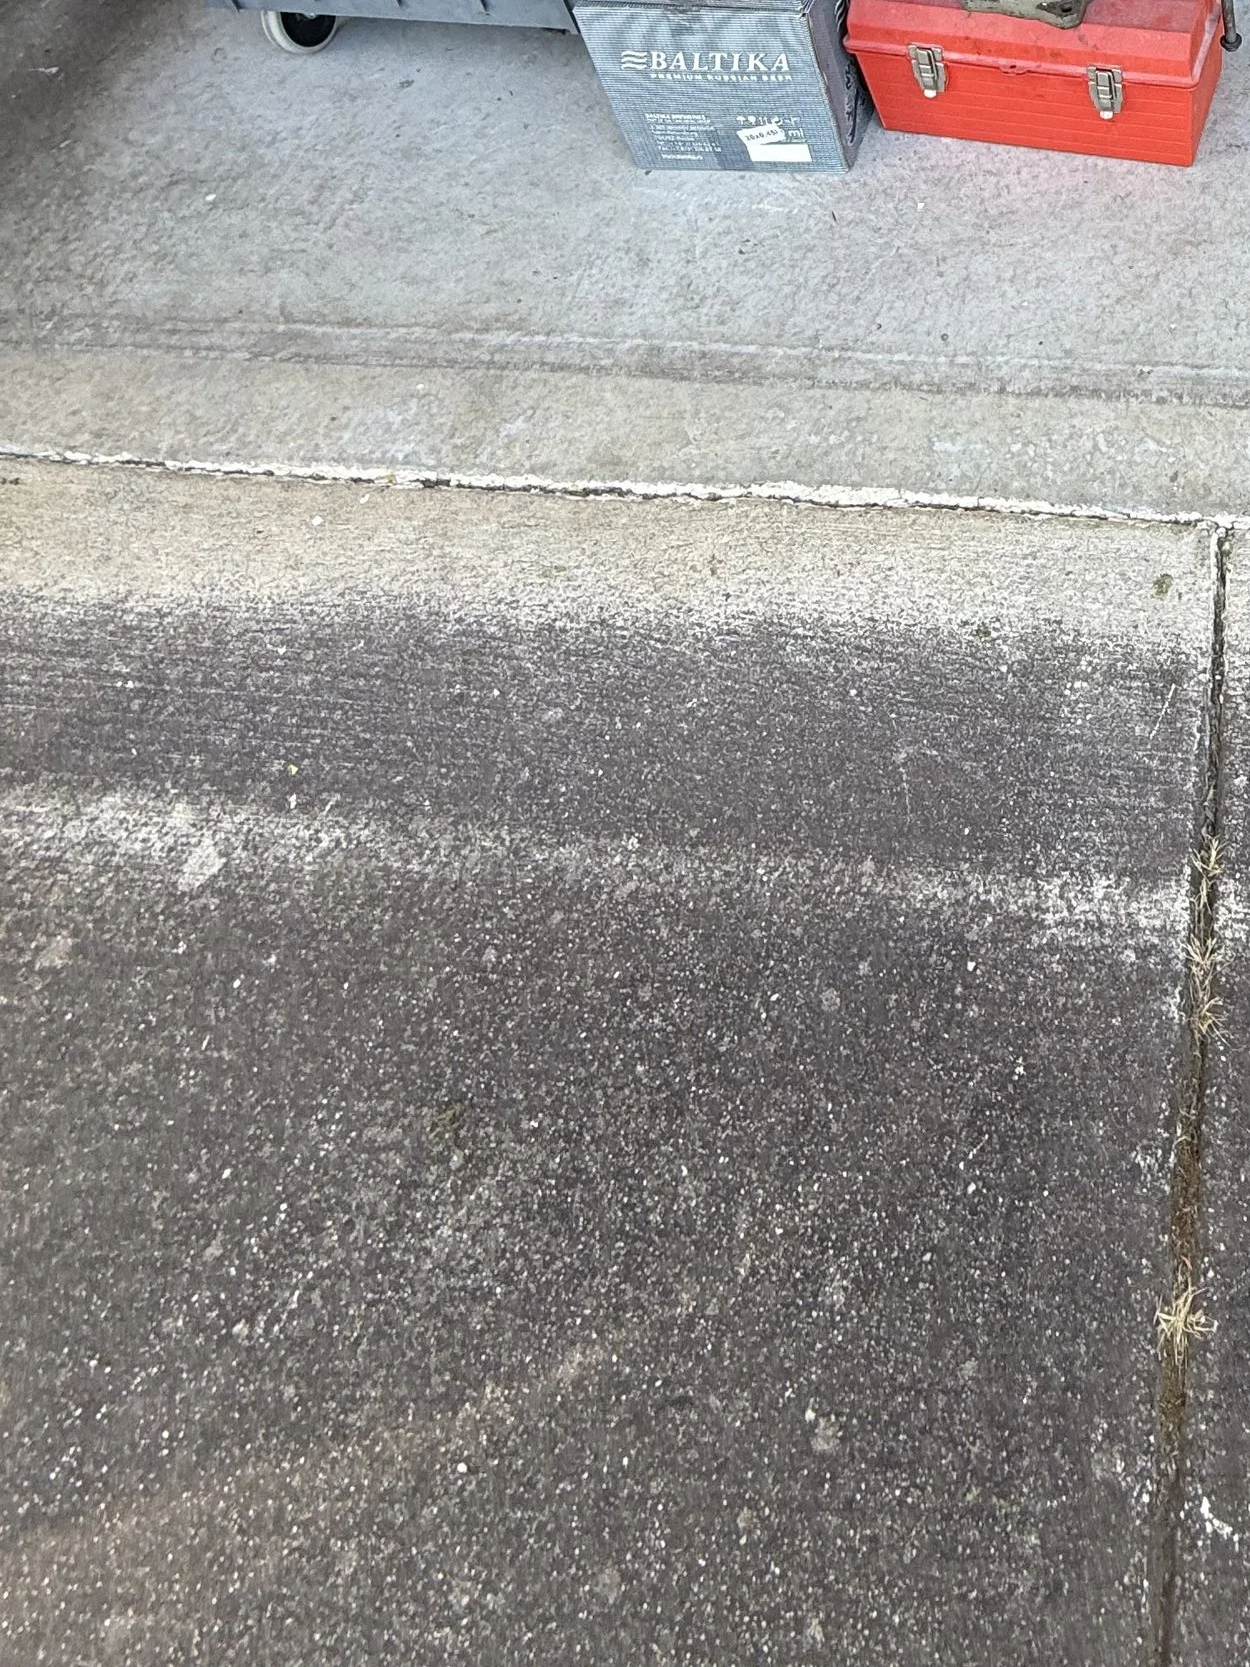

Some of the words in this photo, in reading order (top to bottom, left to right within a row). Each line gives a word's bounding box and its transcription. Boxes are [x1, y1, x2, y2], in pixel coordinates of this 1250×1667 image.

[650, 50, 790, 72] BALTIKA
[650, 72, 702, 81] PREMIUM
[706, 73, 758, 82] RUSSIAN
[761, 74, 793, 82] BEER
